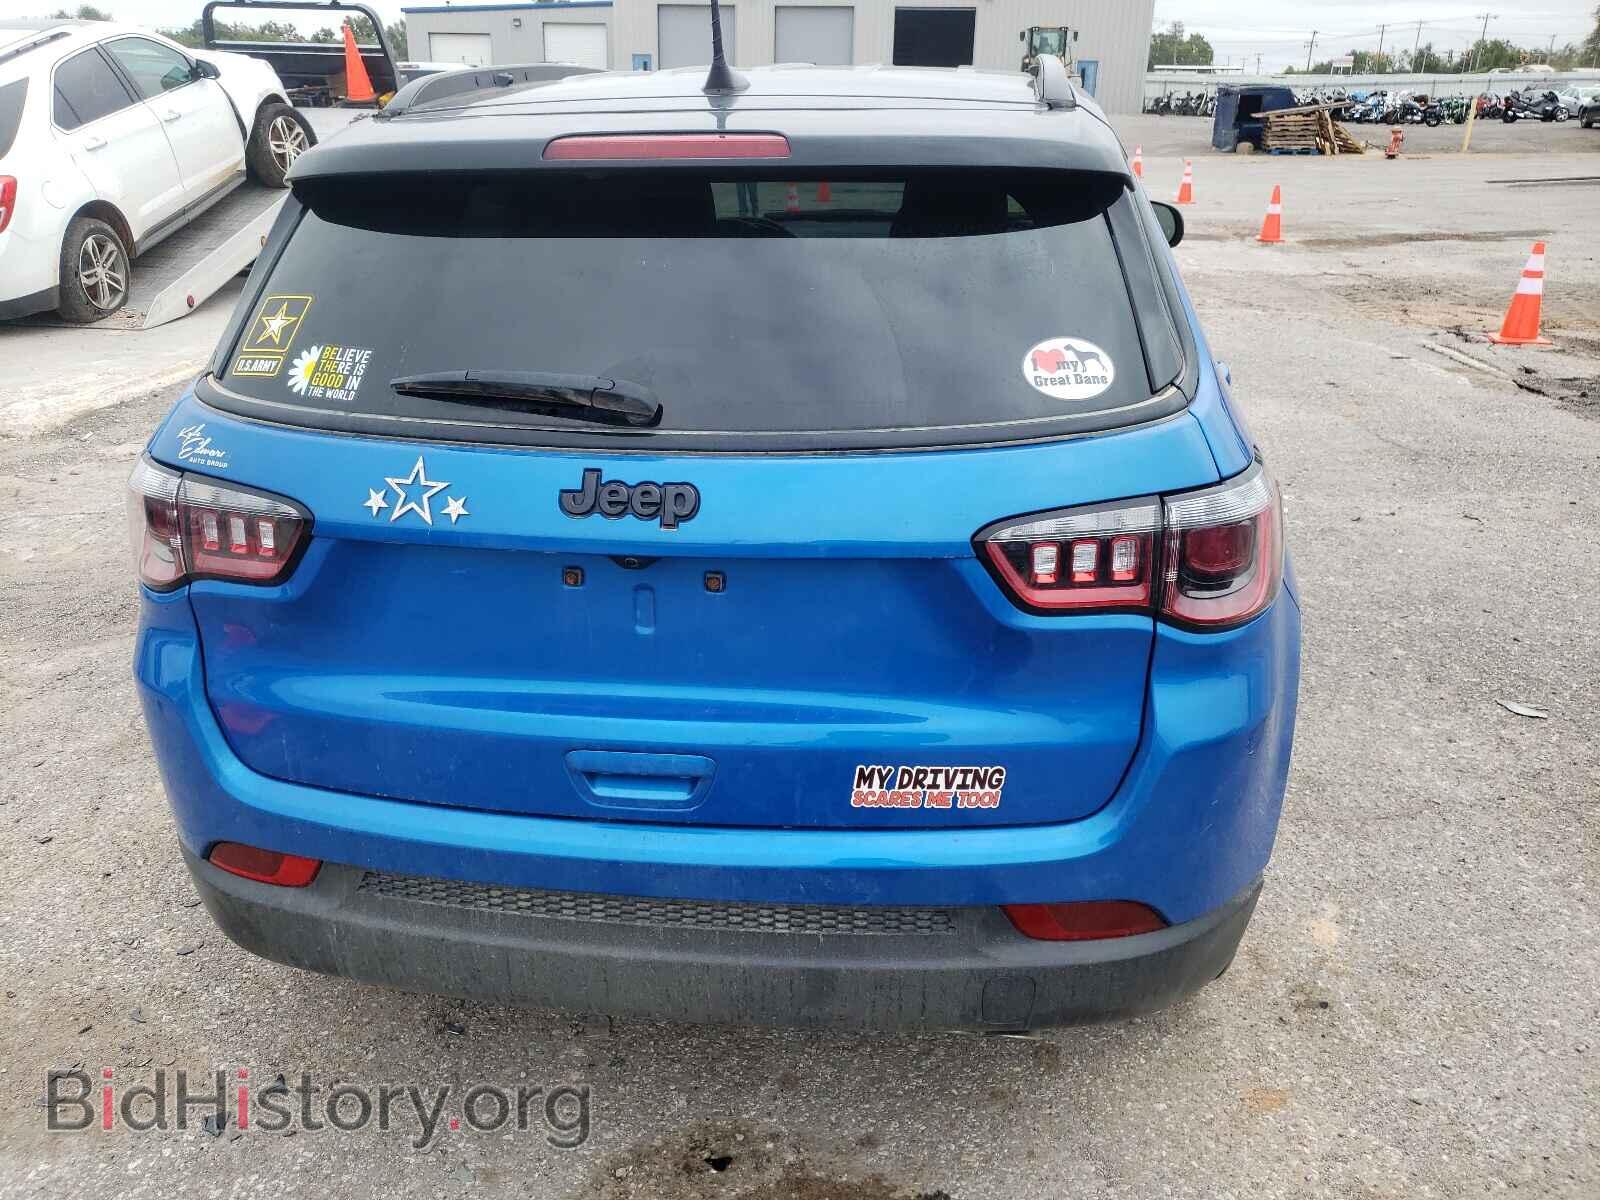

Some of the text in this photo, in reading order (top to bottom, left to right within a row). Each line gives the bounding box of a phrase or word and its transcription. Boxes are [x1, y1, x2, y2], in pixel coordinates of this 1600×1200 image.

[322, 346, 373, 363] BELIEVE
[319, 359, 366, 376] THERE IS
[1056, 360, 1079, 373] my
[312, 372, 361, 390] GOOD IN
[1034, 373, 1109, 387] Great Dane
[308, 386, 356, 400] THE WORLD
[189, 457, 228, 468] AUTO GROUP
[558, 468, 701, 530] Jeep
[854, 766, 1005, 790] MY DRIVING
[852, 790, 1001, 807] SCARES ME TOO!
